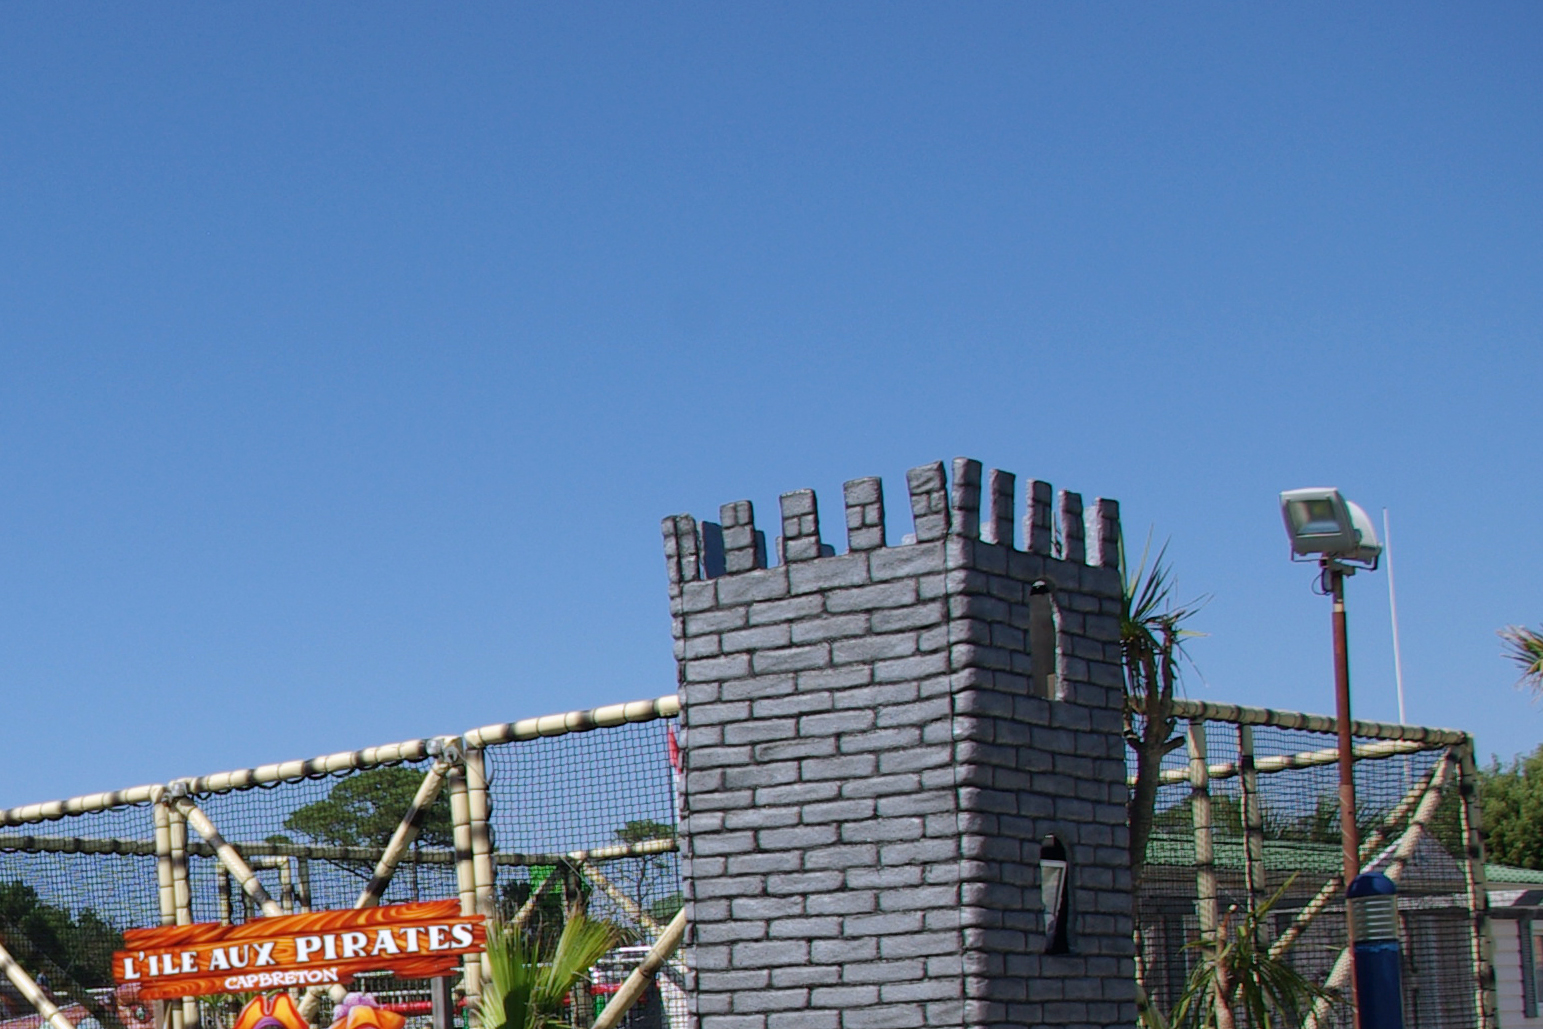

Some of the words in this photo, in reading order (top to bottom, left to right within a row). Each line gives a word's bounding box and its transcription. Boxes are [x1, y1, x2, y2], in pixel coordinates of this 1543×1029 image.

[123, 951, 199, 980] L'ILE
[209, 941, 276, 971] AUX
[295, 923, 474, 963] PIRATES
[224, 967, 339, 991] CAPBRETON
